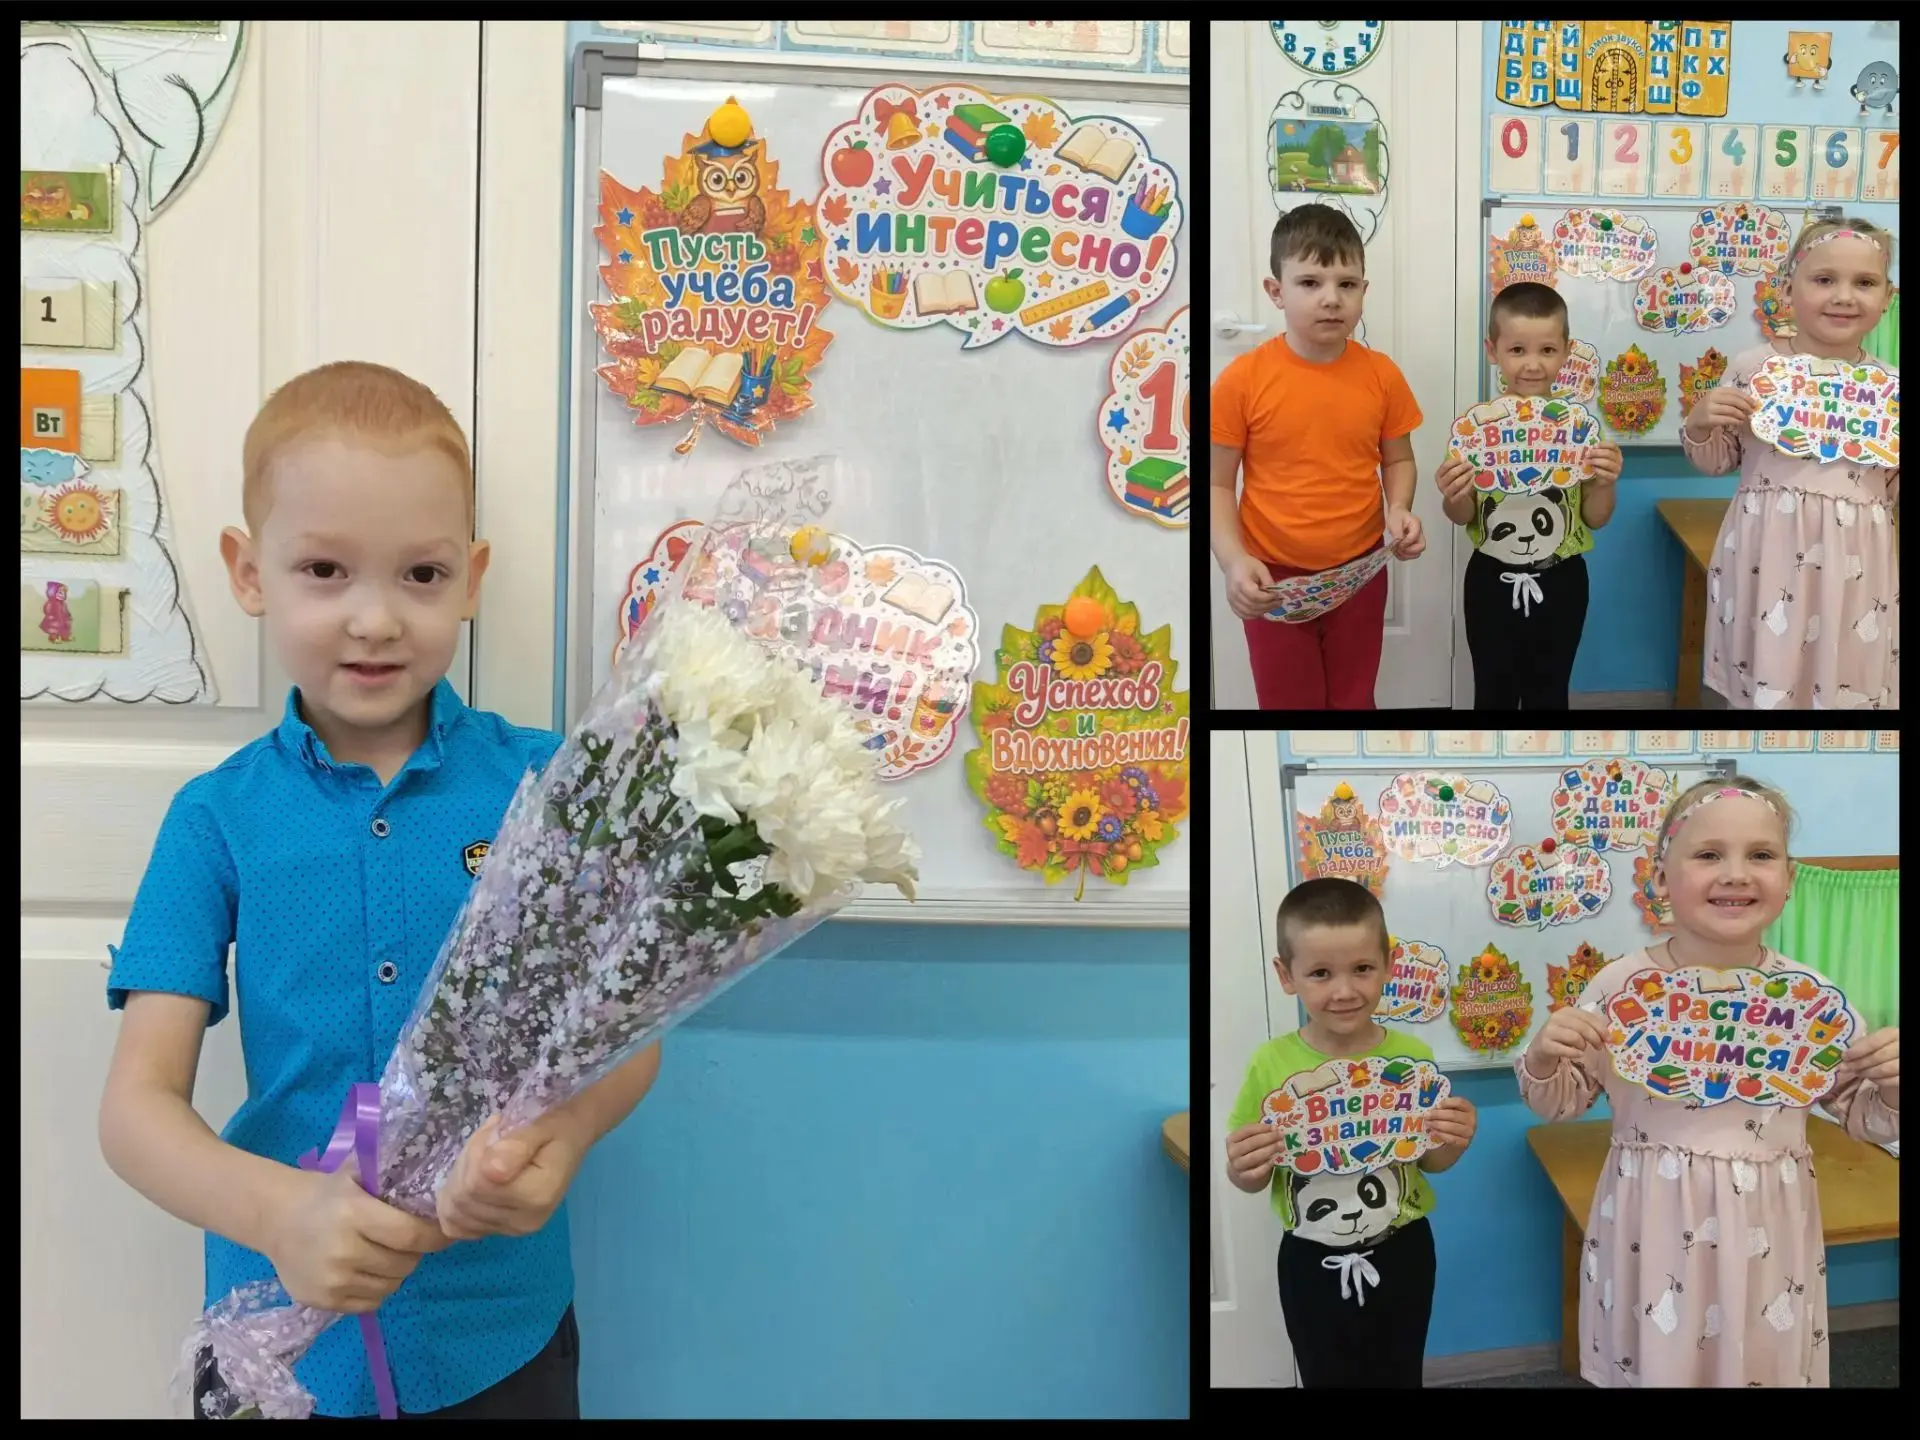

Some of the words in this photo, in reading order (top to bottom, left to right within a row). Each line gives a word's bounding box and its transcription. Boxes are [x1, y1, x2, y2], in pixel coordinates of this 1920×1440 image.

[1284, 33, 1296, 52] 8
[1359, 33, 1371, 52] 4
[1505, 33, 1524, 56] Д
[1562, 24, 1579, 47] Й
[1650, 34, 1674, 52] Ж
[1684, 28, 1701, 47] П
[1711, 30, 1726, 48] Т
[1303, 47, 1316, 65] 7
[1344, 47, 1356, 66] 5
[1532, 38, 1546, 56] Г
[1323, 52, 1335, 71] 6
[1506, 59, 1522, 78] Б
[1561, 53, 1577, 71] Ч
[1651, 56, 1668, 78] Ц
[1683, 56, 1699, 74] К
[1708, 57, 1725, 75] Х
[1505, 81, 1520, 100] Р
[1530, 84, 1548, 102] Л
[1556, 79, 1581, 100] Щ
[1648, 86, 1671, 104] Ш
[1681, 80, 1701, 97] Ф
[1501, 118, 1528, 158] 0
[1561, 122, 1579, 161] 1
[1614, 124, 1639, 163] 2
[1670, 128, 1693, 165] 3
[1721, 128, 1746, 166] 4
[1775, 130, 1797, 168] 5
[1825, 131, 1849, 168] 6
[1879, 133, 1899, 169] 7
[892, 154, 1109, 223] Учиться
[1723, 212, 1767, 233] Ура!
[1575, 228, 1637, 247] Учиться
[1715, 232, 1762, 246] День
[643, 228, 765, 271] Пусть
[856, 212, 1167, 284] интересно!
[1504, 250, 1538, 262] Пусть
[1564, 245, 1653, 264] интересно!
[1707, 244, 1775, 259] знаний!
[661, 263, 794, 309] учёба
[1646, 285, 1657, 310] 1
[41, 296, 56, 322] 1
[641, 304, 814, 350] радует!
[1611, 369, 1653, 389] Успехов
[1791, 375, 1876, 405] Растём
[1139, 361, 1178, 450] 1
[1824, 400, 1838, 413] и
[36, 413, 60, 433] Вт
[1776, 405, 1890, 441] Учимся!
[1483, 424, 1567, 447] Вперёд
[1468, 454, 1480, 467] к
[1009, 661, 1162, 726] Успехов
[1077, 714, 1094, 735] и
[1591, 771, 1644, 797] Ура!
[1406, 800, 1486, 820] Учиться
[1583, 797, 1640, 814] День
[1574, 810, 1656, 830] знаний!
[1316, 831, 1361, 846] Пусть
[1394, 821, 1507, 841] интересно!
[1324, 843, 1373, 861] учёба
[1317, 856, 1382, 876] радует!
[1502, 868, 1516, 901] 1
[1518, 869, 1604, 893] Сентября!
[1464, 974, 1517, 999] Успехов
[1669, 992, 1795, 1030] Растём
[1715, 1025, 1736, 1042] и
[1646, 1035, 1810, 1075] Учимся!
[1305, 1088, 1412, 1123] Вперёд
[1285, 1132, 1302, 1150] к
[1307, 1115, 1431, 1146] знаниям
